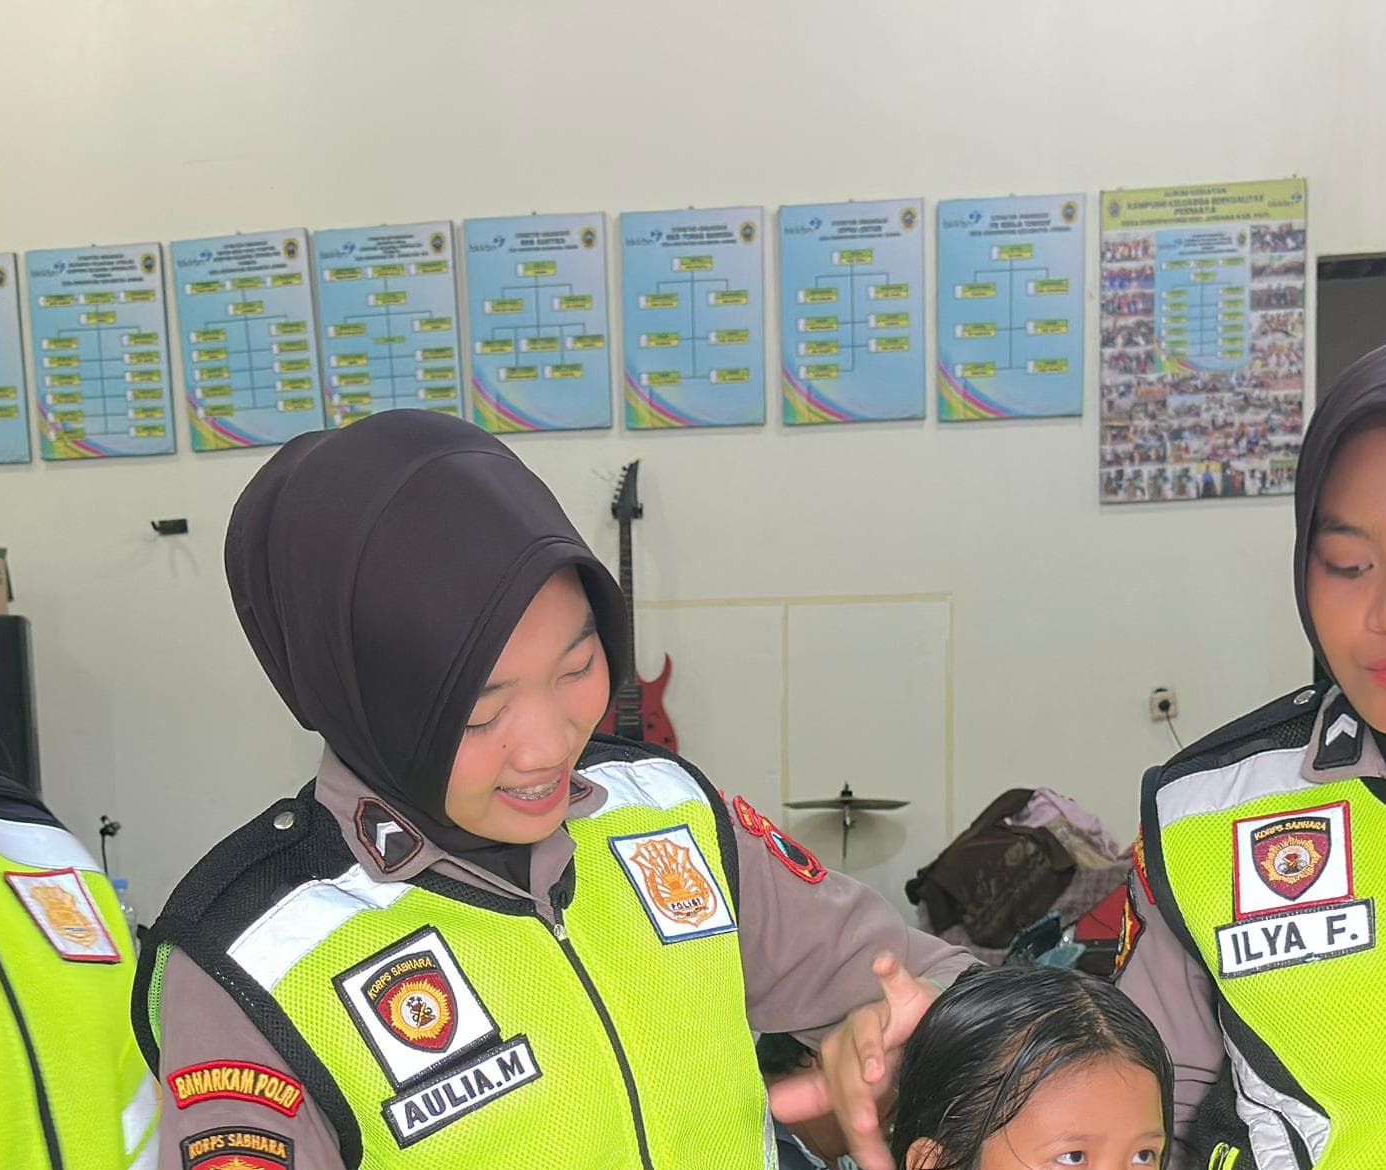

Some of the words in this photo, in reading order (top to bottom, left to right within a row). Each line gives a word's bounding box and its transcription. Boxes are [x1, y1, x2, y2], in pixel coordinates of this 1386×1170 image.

[1230, 921, 1307, 966] ILYA
[1326, 913, 1359, 946] F.
[366, 972, 392, 1000] KORPS
[175, 1066, 255, 1100] BAHARKAM
[403, 1049, 526, 1130] AULIA.M
[188, 1135, 225, 1160] KORPS
[228, 1132, 288, 1158] SABHARA
